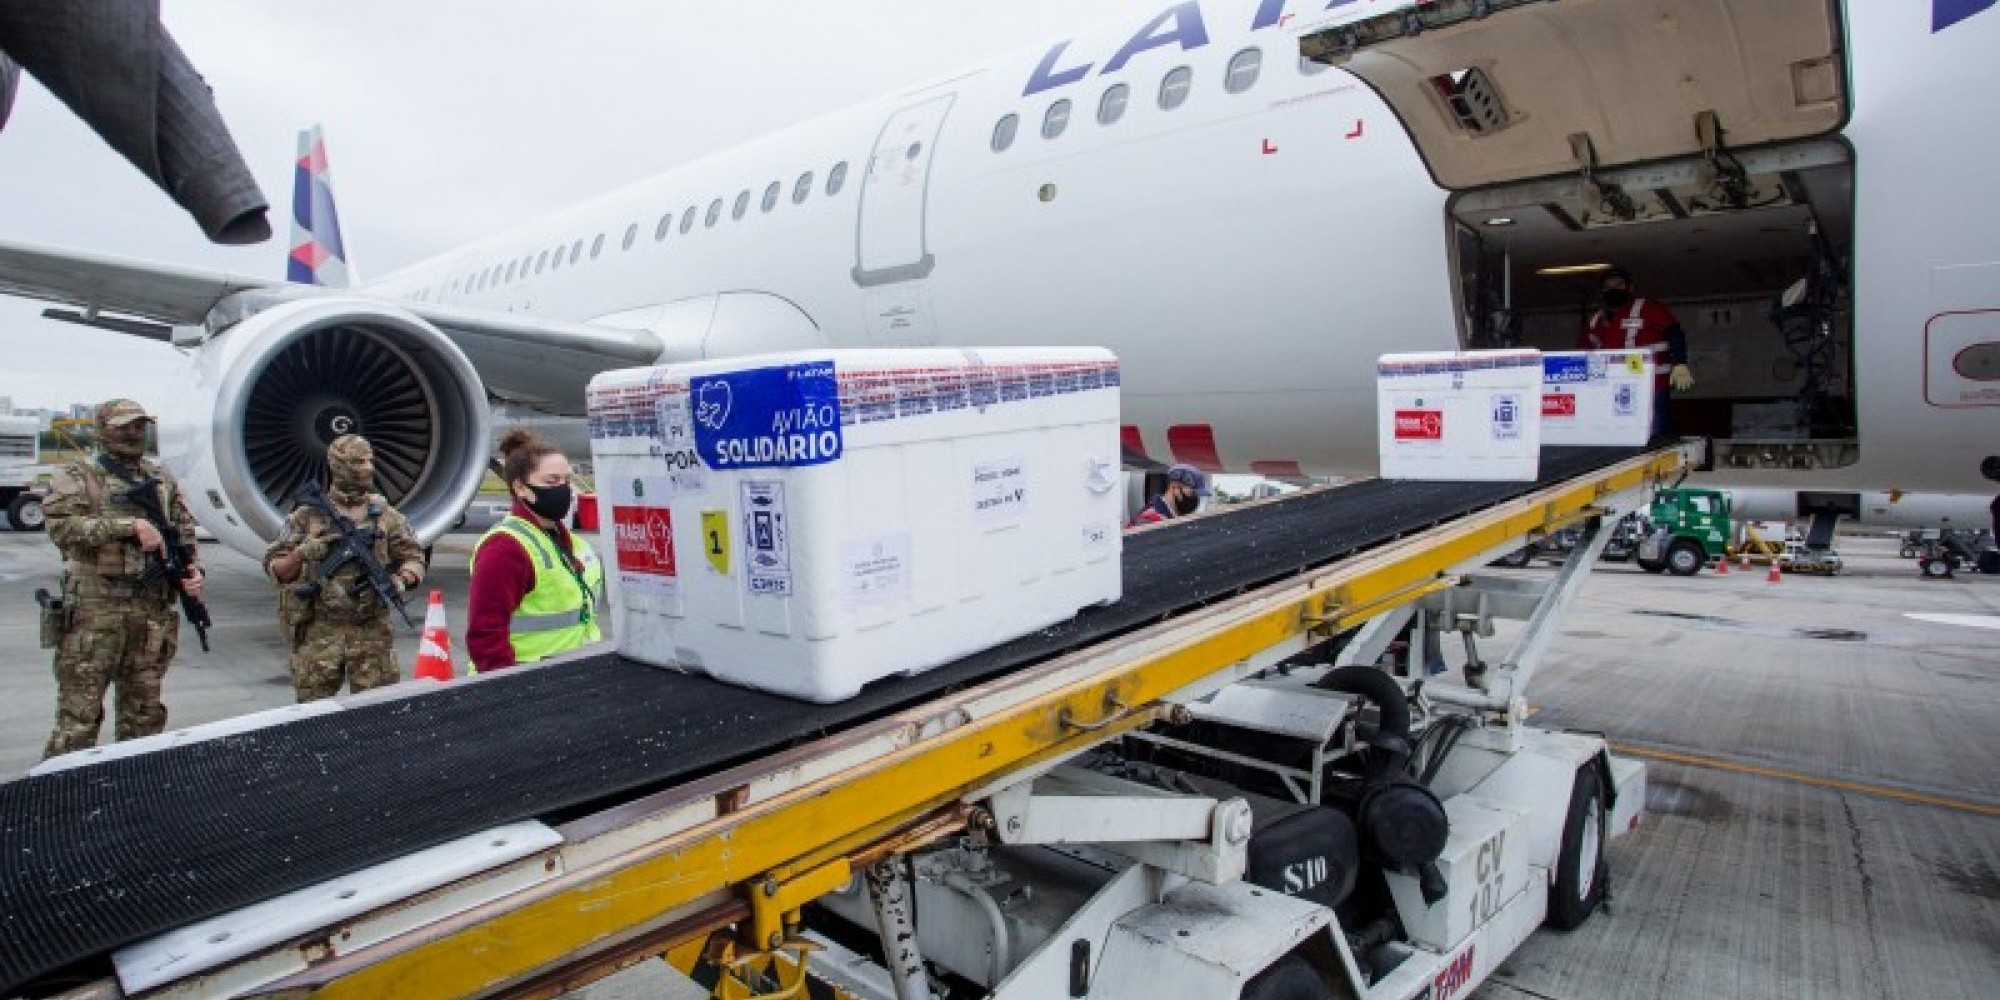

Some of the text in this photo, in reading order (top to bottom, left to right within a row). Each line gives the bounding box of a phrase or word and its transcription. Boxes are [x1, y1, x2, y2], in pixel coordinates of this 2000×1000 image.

[772, 402, 834, 434] AVIÃO
[665, 449, 700, 472] POA
[716, 430, 838, 464] SOLIDÁRIO
[709, 530, 723, 555] 1
[1478, 829, 1505, 884] CV
[1285, 856, 1326, 896] S10
[1470, 873, 1505, 931] 107
[1435, 944, 1475, 1000] TAM
